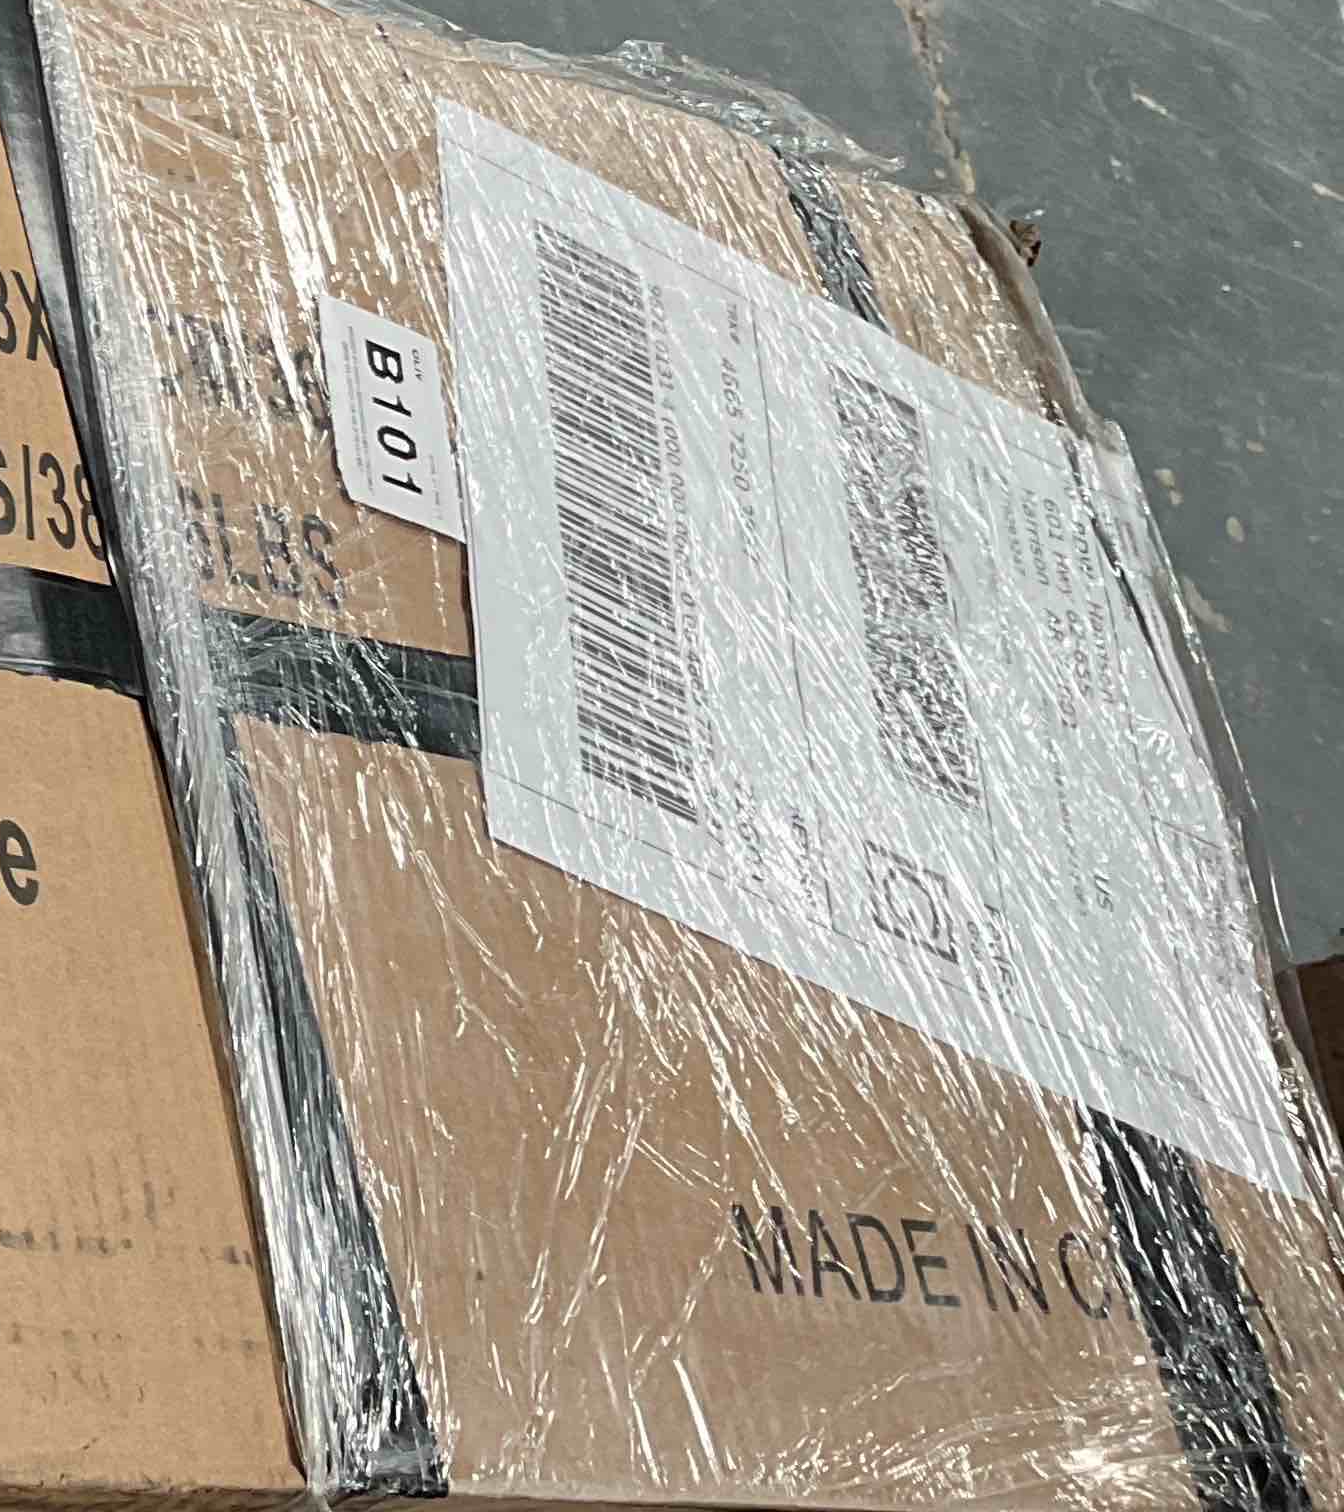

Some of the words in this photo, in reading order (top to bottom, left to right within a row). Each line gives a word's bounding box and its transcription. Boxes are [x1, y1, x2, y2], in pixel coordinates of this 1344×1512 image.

[365, 339, 423, 499] B101
[726, 424, 752, 496] 7250
[731, 1201, 962, 1310] MADE
[966, 1222, 1053, 1317] IN
